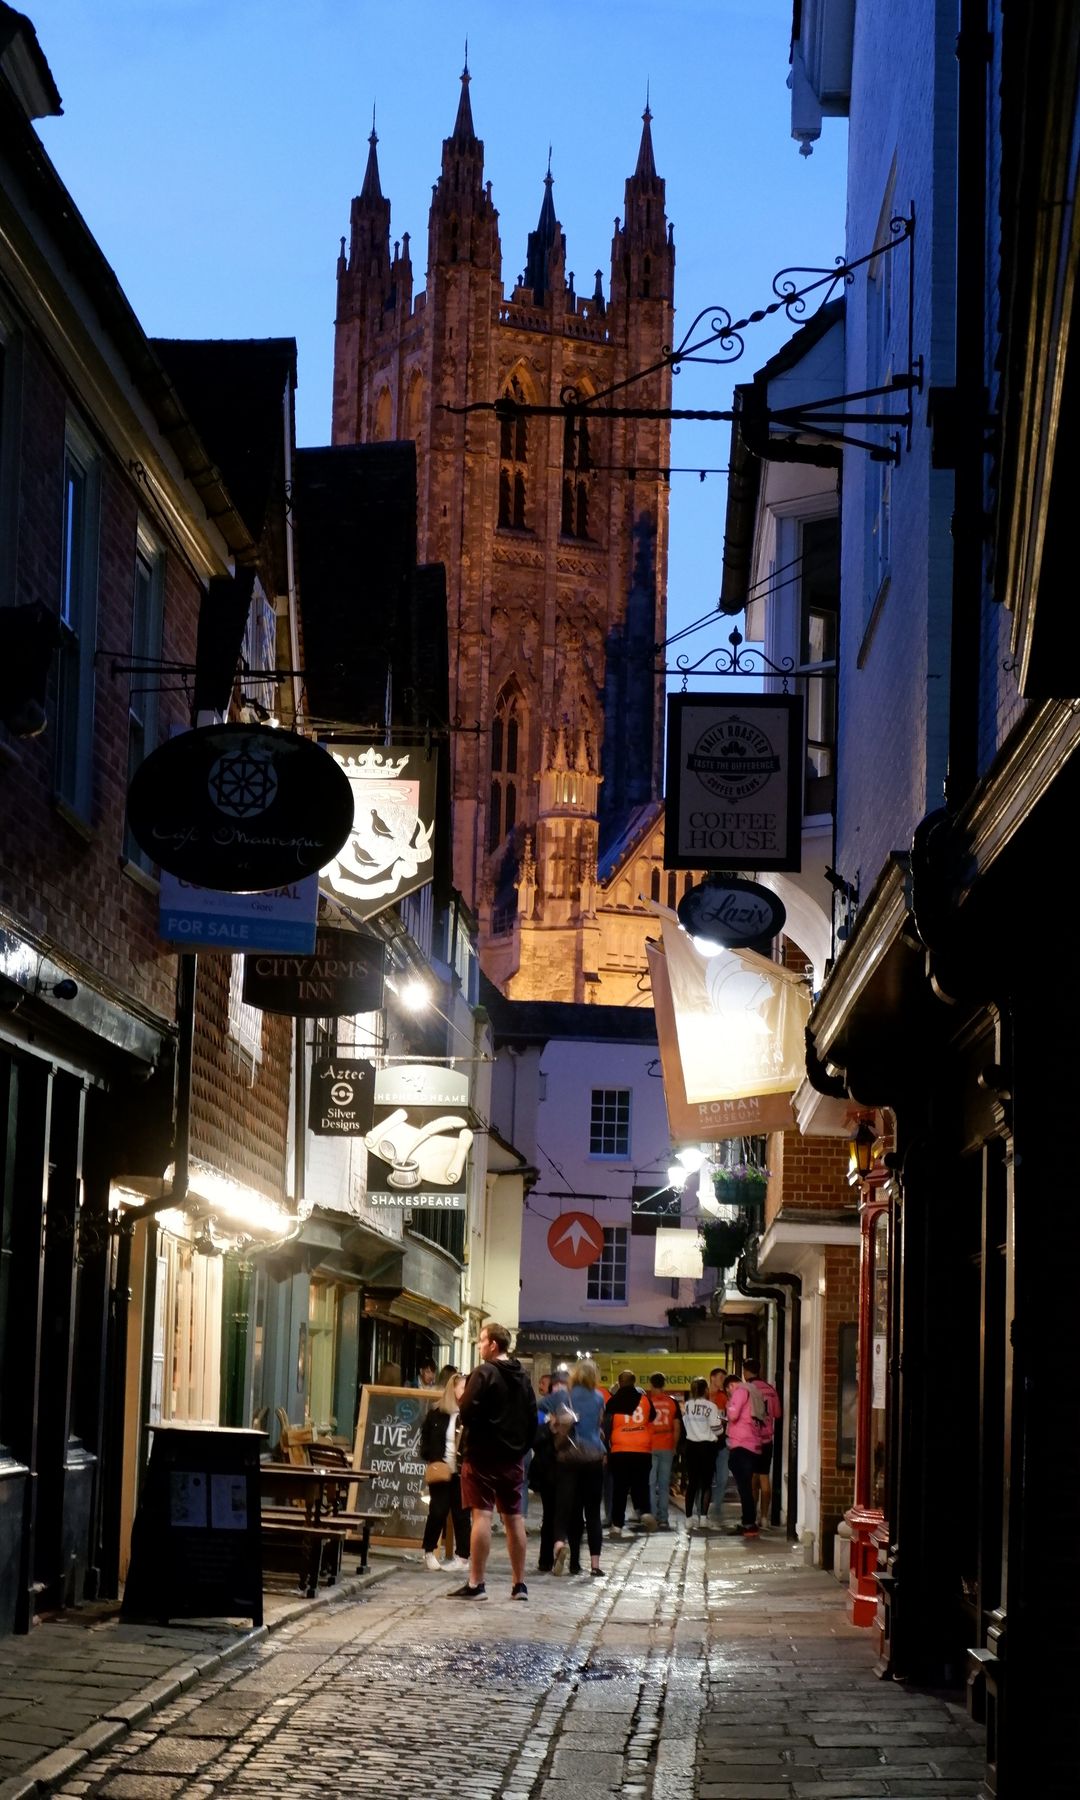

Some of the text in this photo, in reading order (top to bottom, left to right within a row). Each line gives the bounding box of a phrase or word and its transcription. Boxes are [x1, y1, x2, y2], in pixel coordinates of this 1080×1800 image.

[700, 726, 768, 753] DAILY ROASTED
[689, 812, 777, 830] COFFEE
[689, 830, 777, 850] HOUSE
[168, 917, 203, 935] FOR
[208, 920, 249, 939] SALE
[255, 959, 369, 978] CITY ARMS
[298, 981, 333, 1000] INN
[320, 1065, 366, 1081] Aztec
[327, 1108, 356, 1119] Silver
[698, 1098, 759, 1115] ROMAN
[321, 1118, 360, 1132] Designs
[705, 1111, 755, 1123] MUSEUM
[371, 1195, 460, 1207] SHAKESPEARE
[691, 1404, 712, 1417] JETS
[373, 1425, 408, 1448] LIVE
[371, 1460, 428, 1476] EVERY WEEKEN
